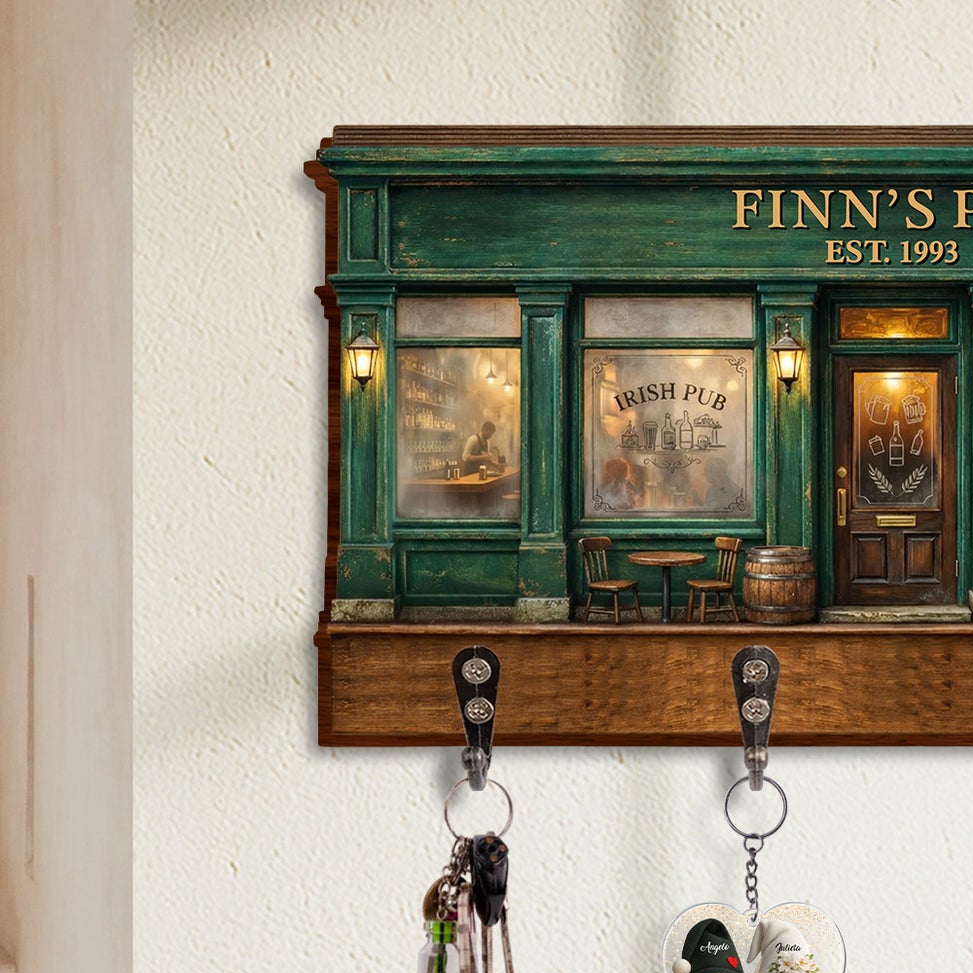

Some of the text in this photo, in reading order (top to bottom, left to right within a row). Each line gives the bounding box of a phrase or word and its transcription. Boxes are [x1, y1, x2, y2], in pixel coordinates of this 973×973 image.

[732, 188, 935, 230] FINN’S
[825, 239, 959, 264] EST. 1993
[613, 382, 727, 412] IRISH PUB
